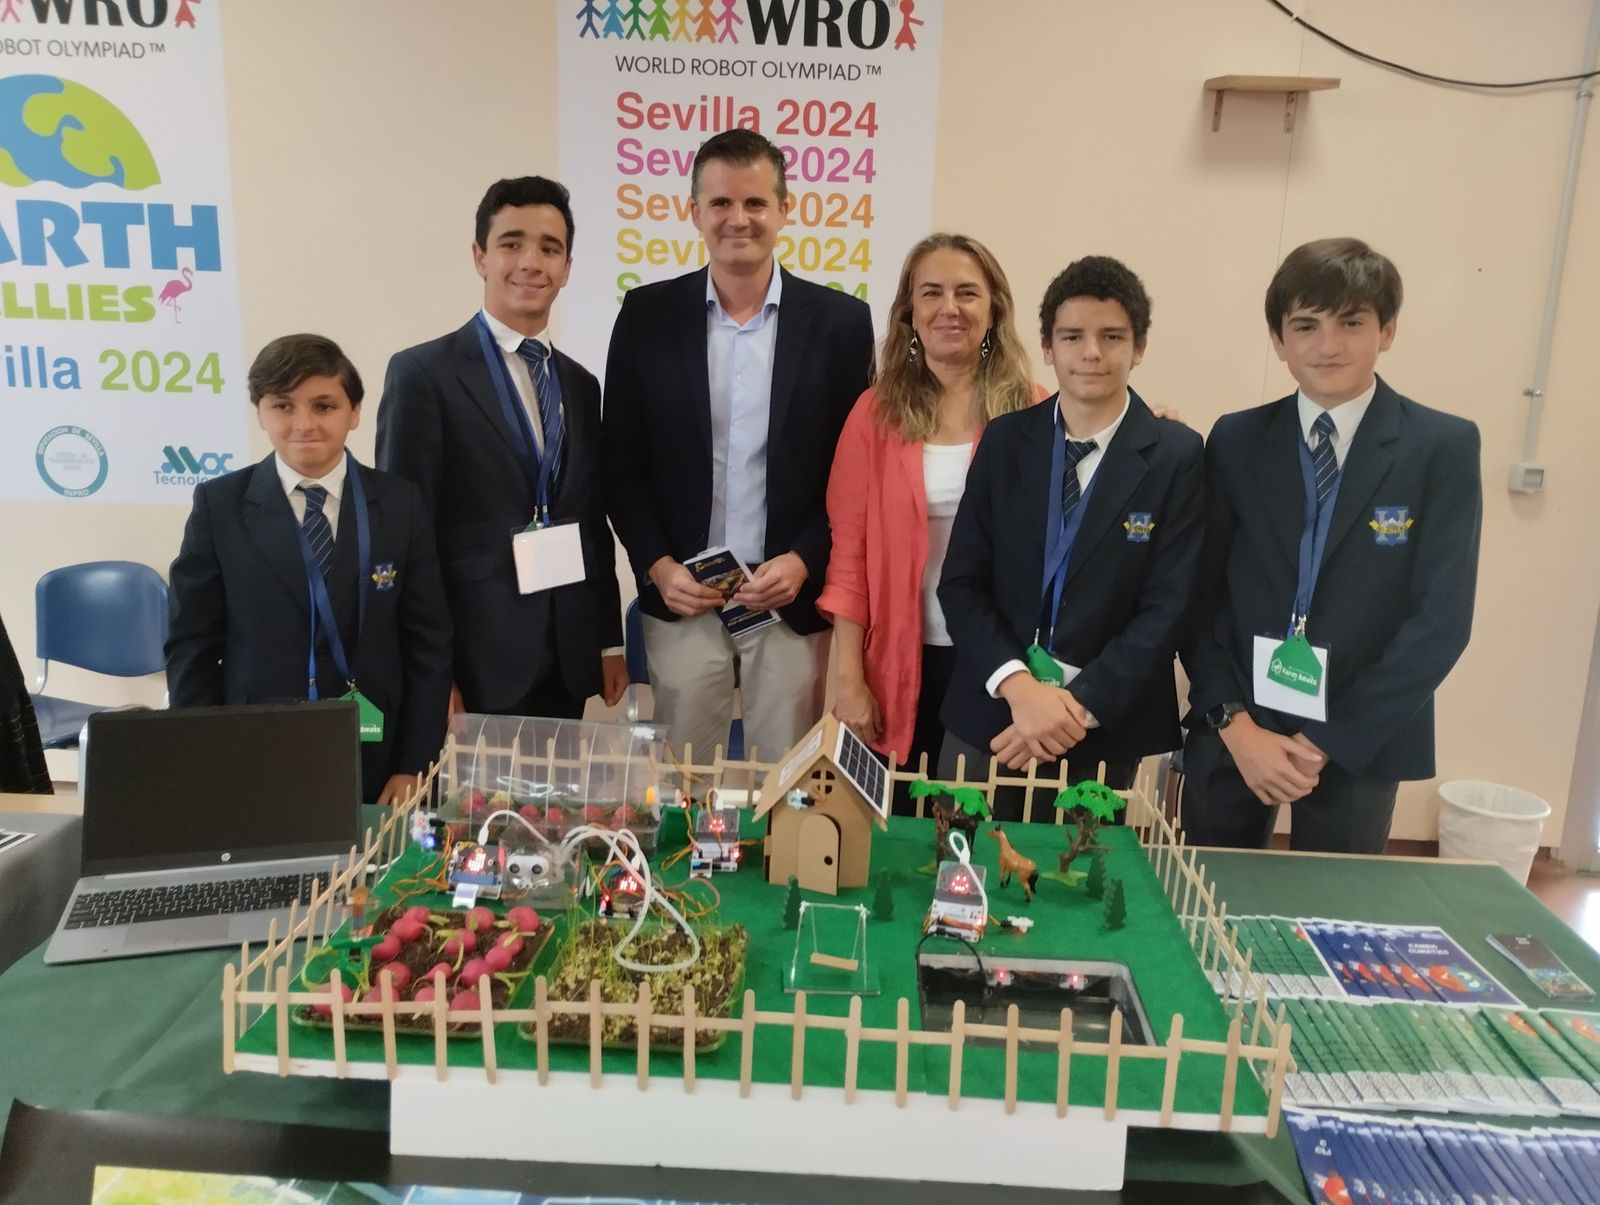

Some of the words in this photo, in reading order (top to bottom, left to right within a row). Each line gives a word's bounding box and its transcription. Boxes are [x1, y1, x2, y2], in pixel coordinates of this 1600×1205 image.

[746, 0, 891, 50] WRO
[0, 38, 42, 56] BOT
[47, 40, 146, 59] OLYMPIAD
[615, 56, 686, 76] WORLD
[691, 58, 758, 78] ROBOT
[762, 61, 862, 81] OLYMPIAD
[616, 91, 761, 133] Sevilla
[776, 98, 879, 138] 2024
[783, 145, 877, 184] 2024
[0, 199, 222, 272] RTH
[0, 281, 156, 323] LLIES
[4, 344, 81, 390] illa
[99, 348, 226, 394] 2024
